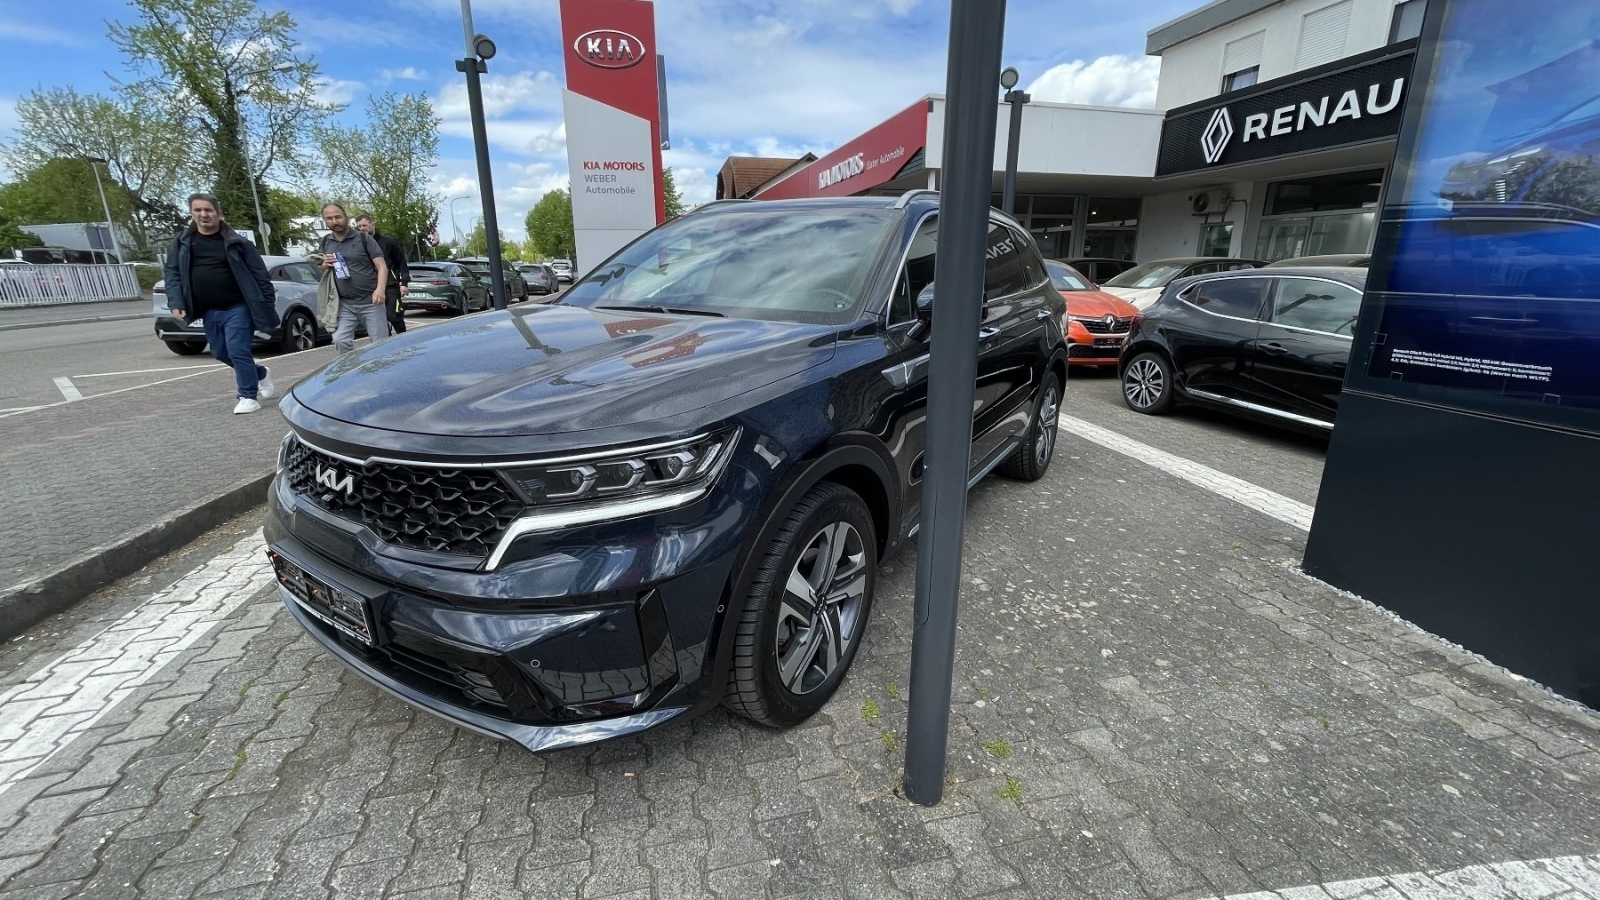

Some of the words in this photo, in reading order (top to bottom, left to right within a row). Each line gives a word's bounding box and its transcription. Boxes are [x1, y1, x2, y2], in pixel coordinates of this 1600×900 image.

[587, 37, 633, 60] KIA
[1243, 77, 1404, 143] RENAU
[880, 146, 905, 164] Automobile
[583, 161, 600, 170] KIA
[603, 162, 645, 171] MOTORS
[584, 174, 617, 183] WEBER
[585, 186, 636, 194] Automobile
